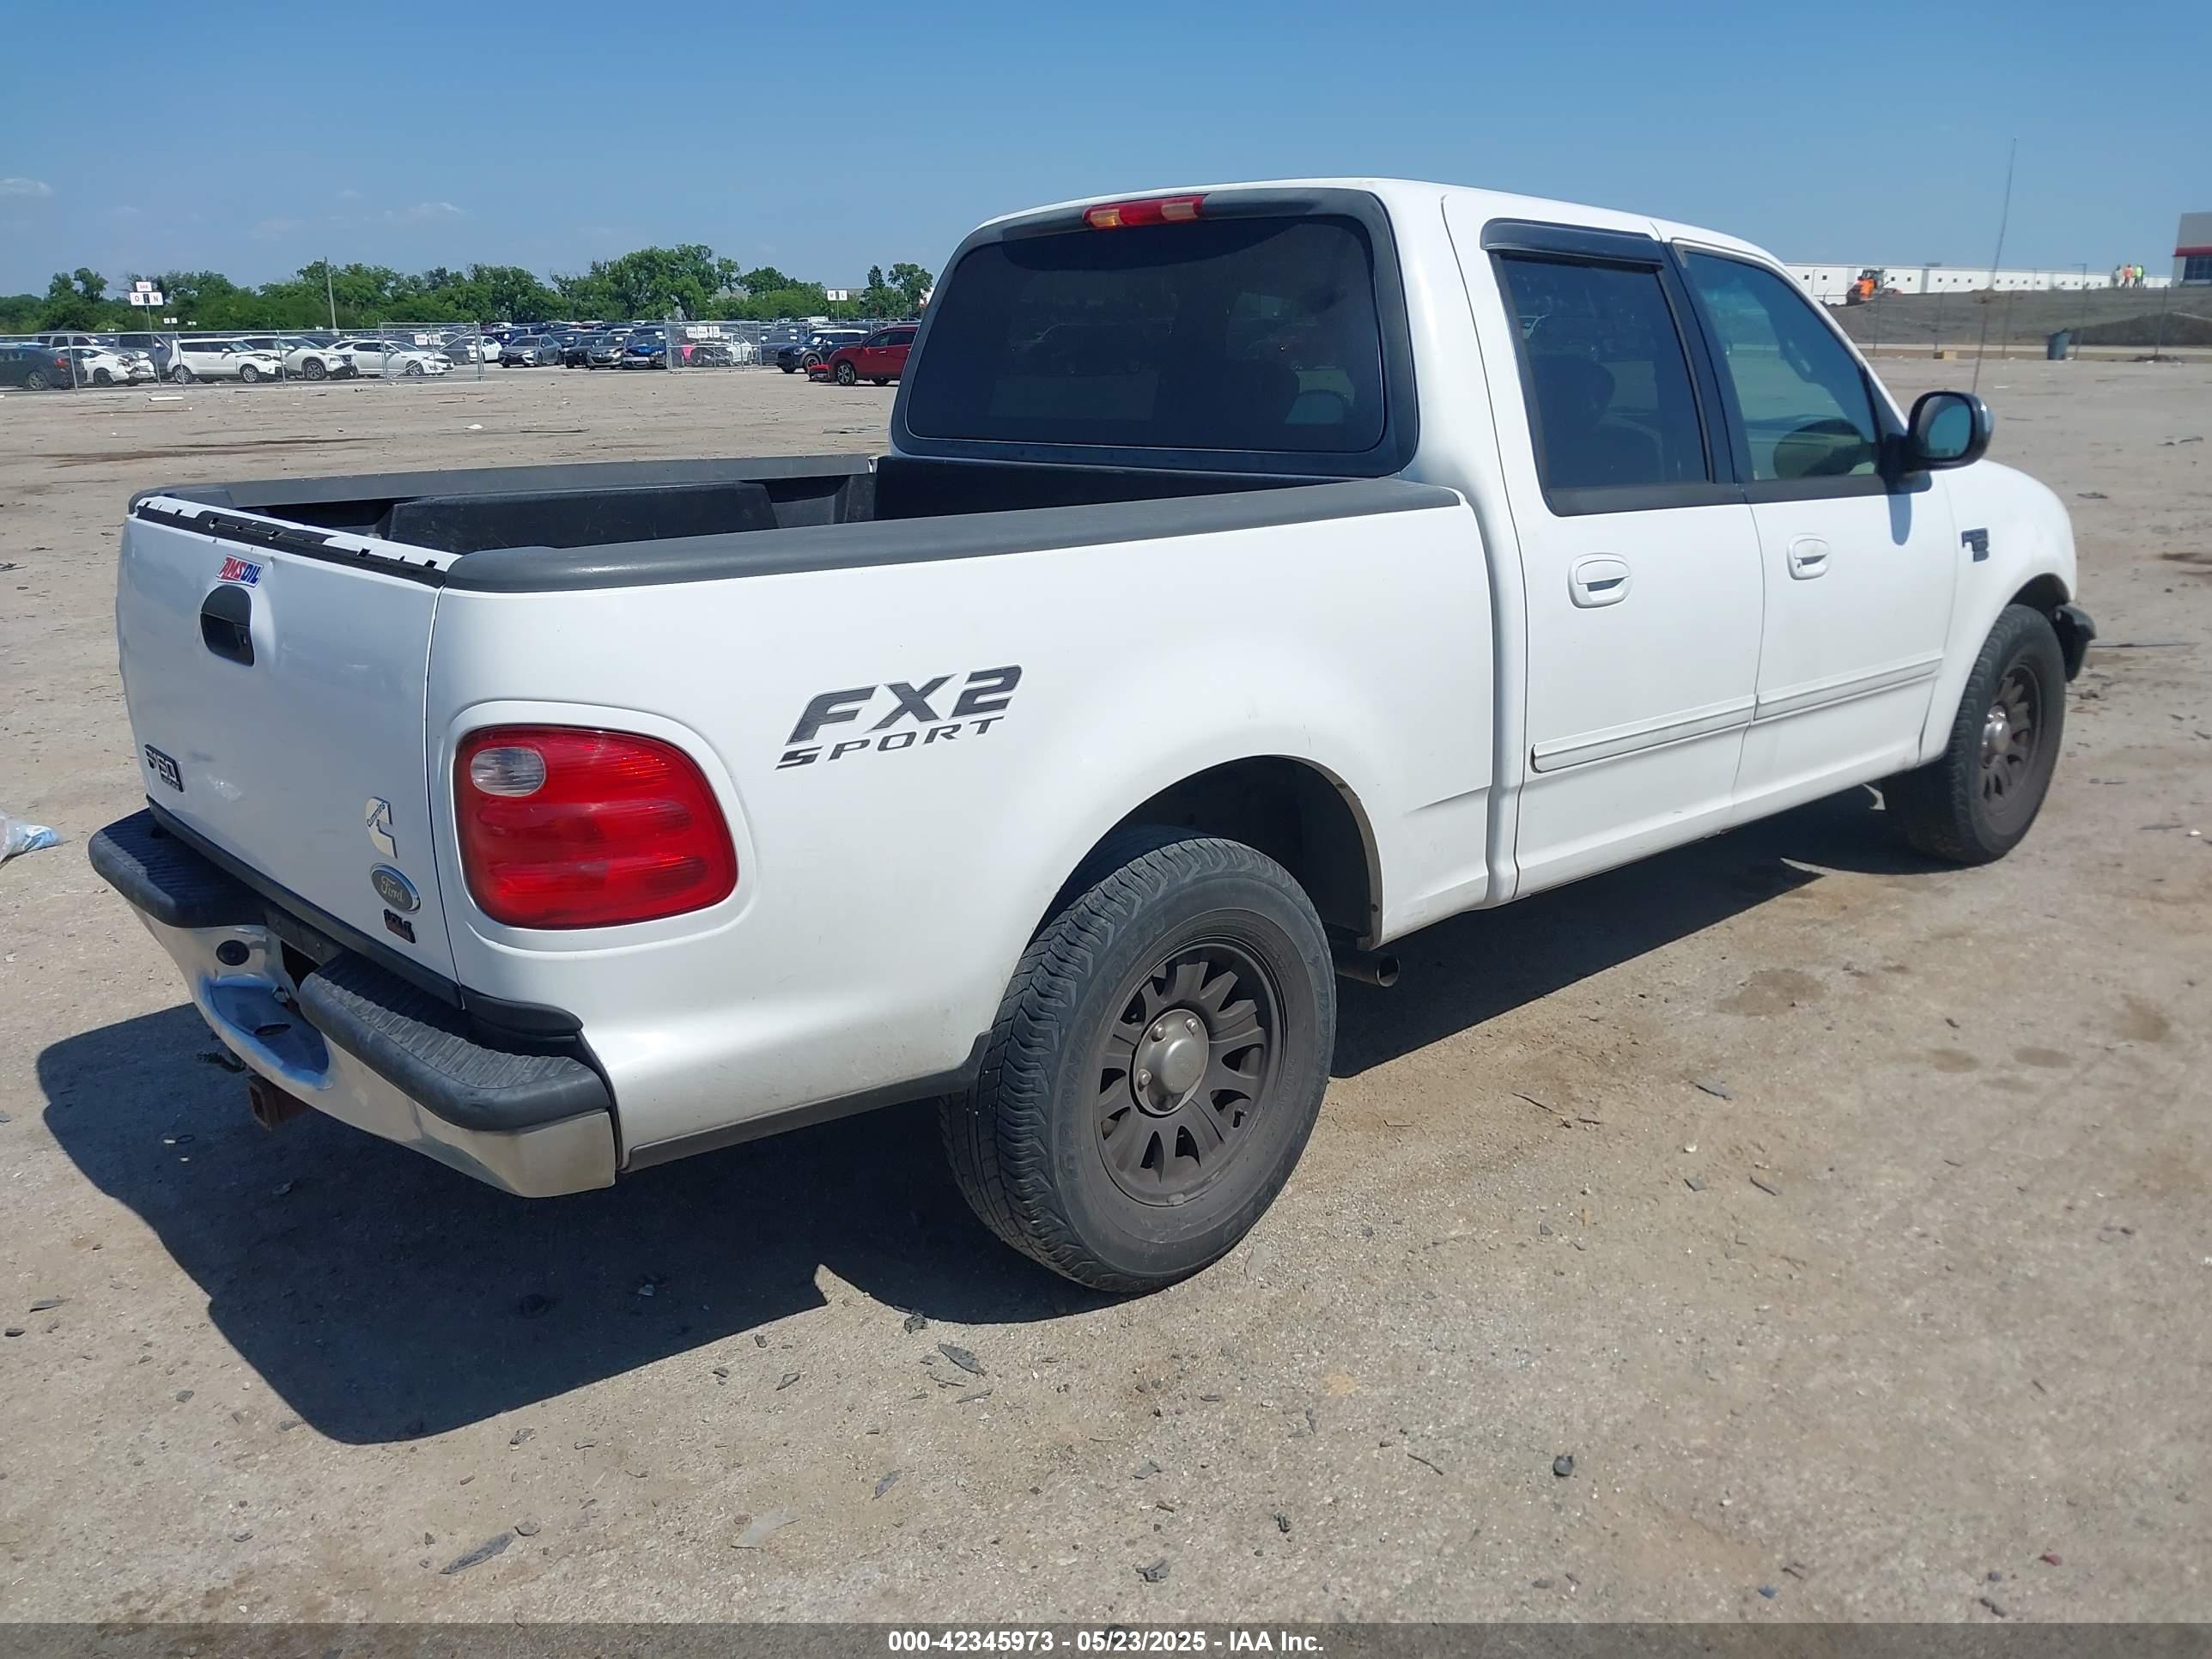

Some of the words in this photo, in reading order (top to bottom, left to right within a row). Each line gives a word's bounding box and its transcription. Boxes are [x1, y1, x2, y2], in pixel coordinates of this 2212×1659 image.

[218, 556, 262, 586] AMSOIL
[785, 665, 1023, 746] FX2
[773, 714, 1006, 771] SPORT
[380, 874, 405, 902] Ford
